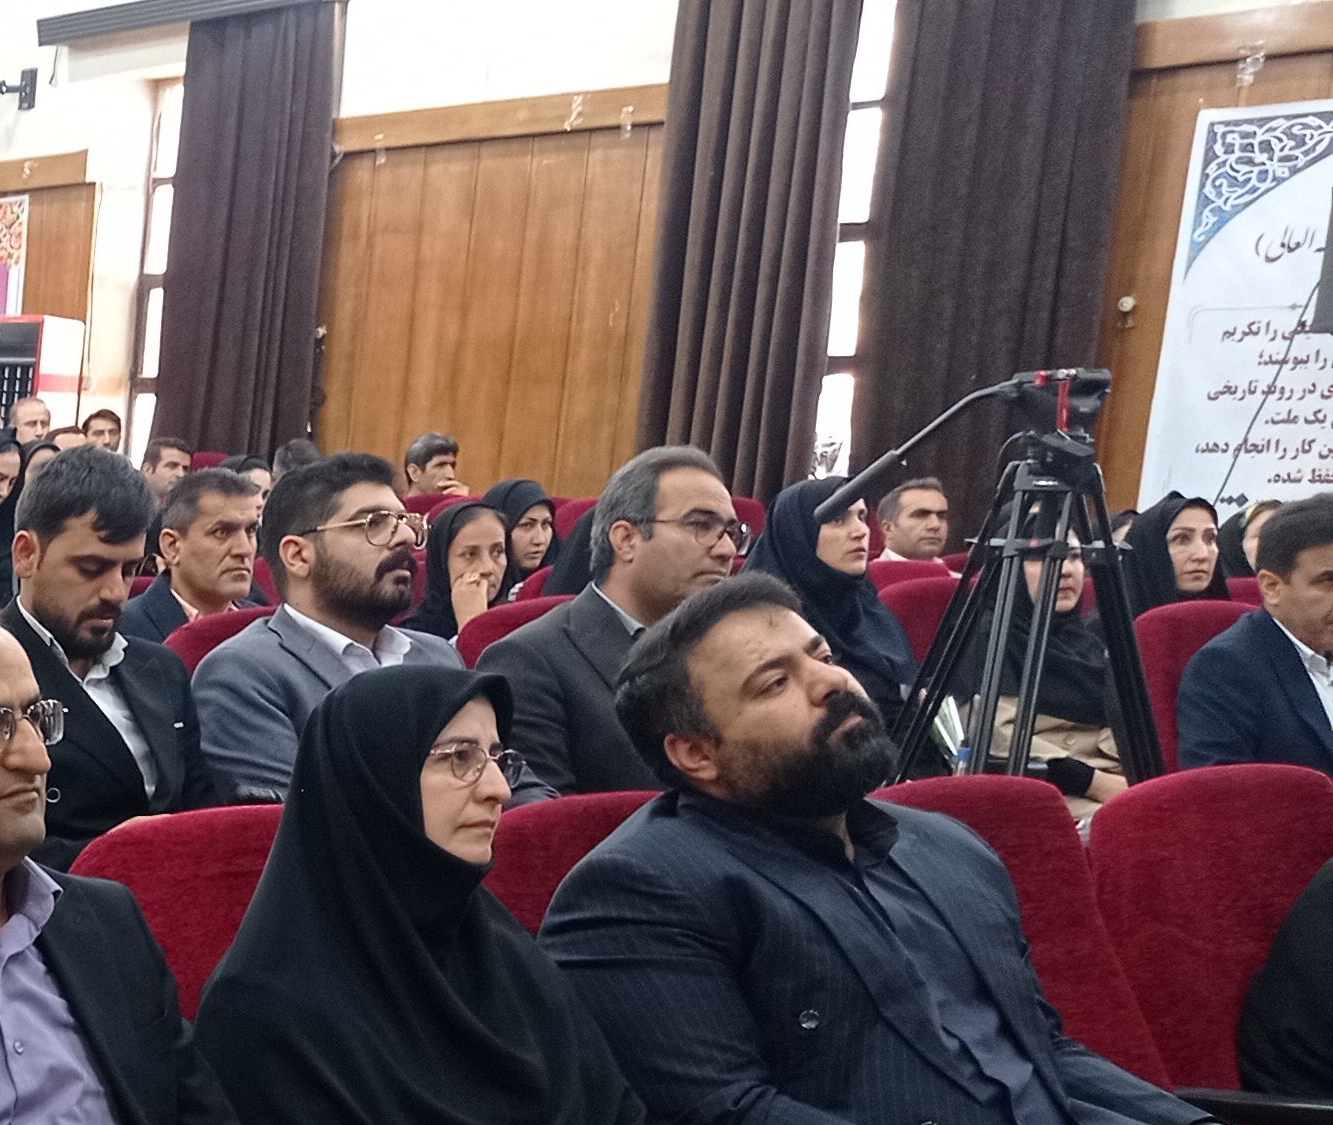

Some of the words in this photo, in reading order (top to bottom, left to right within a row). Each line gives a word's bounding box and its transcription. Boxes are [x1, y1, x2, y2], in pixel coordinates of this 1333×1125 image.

[1221, 320, 1262, 343] تکریم
[1265, 320, 1277, 342] را
[1207, 380, 1259, 402] تاریخی
[1297, 382, 1317, 401] در
[1304, 408, 1327, 429] یک
[1276, 438, 1287, 460] را
[1290, 438, 1316, 460] کار
